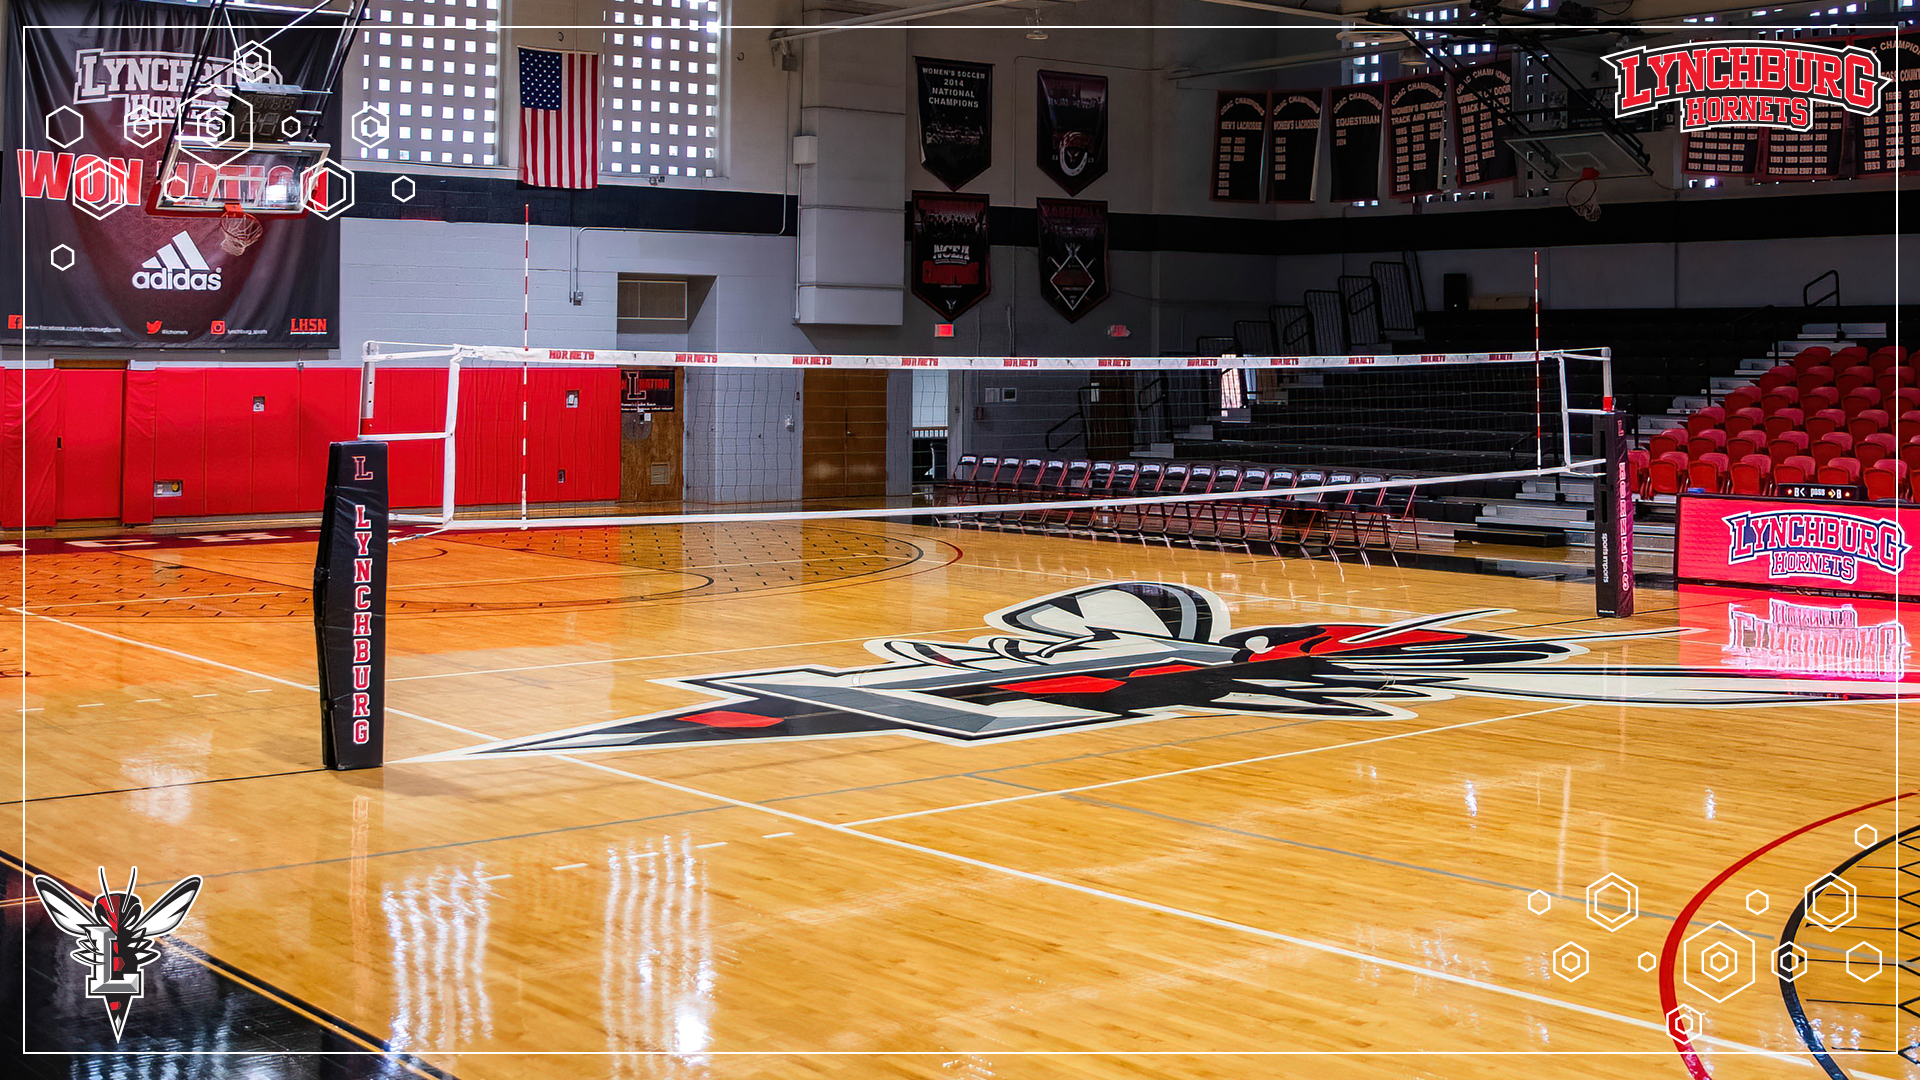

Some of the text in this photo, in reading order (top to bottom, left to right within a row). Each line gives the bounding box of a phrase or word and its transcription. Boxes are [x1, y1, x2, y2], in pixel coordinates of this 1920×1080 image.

[922, 67, 985, 80] WOMEN'S SOCCER
[944, 79, 964, 87] 2014
[932, 87, 975, 98] NATIONAL
[929, 97, 979, 108] CHAMPIONS
[1336, 115, 1380, 127] EQUESTRIAN
[1391, 115, 1411, 126] TRACK
[1412, 113, 1425, 122] AND
[17, 149, 143, 206] WON
[132, 270, 221, 291] adidas
[291, 318, 327, 332] LHSN
[549, 350, 595, 360] HORNETS
[675, 353, 718, 363] HORNETS
[792, 356, 832, 366] HORNETS
[901, 357, 939, 367] HORNETS
[1004, 358, 1038, 367] HORNETS
[1099, 358, 1133, 366] HORNETS
[1187, 358, 1218, 366] HORNETS
[1271, 358, 1299, 366] HORNETS
[628, 371, 647, 400] L
[352, 456, 374, 481] L
[1733, 513, 1901, 570] LYNCHBURG
[1772, 551, 1855, 581] HORNETS
[353, 504, 373, 745] LYNCHBURG
